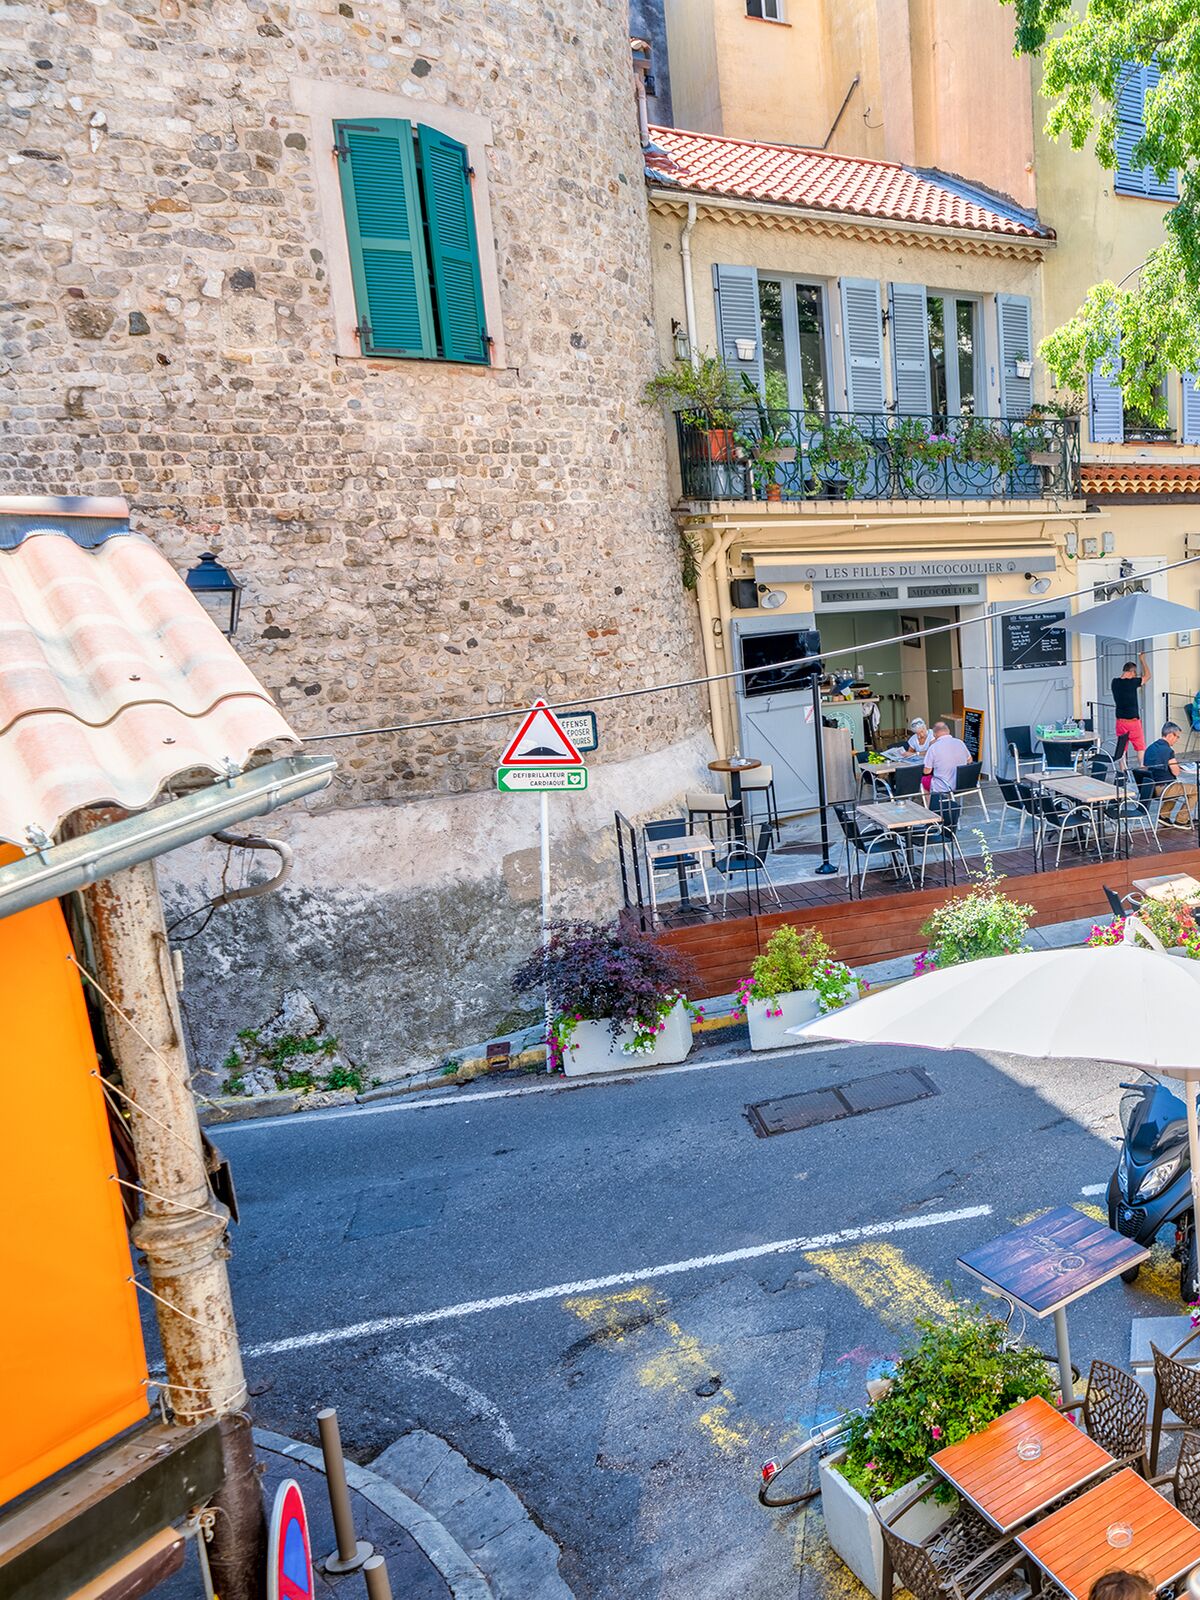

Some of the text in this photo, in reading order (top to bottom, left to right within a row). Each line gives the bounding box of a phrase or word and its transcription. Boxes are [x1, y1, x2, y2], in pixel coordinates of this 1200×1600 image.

[825, 562, 1003, 579] LES FILLES DU MICOCOULIER
[826, 586, 974, 601] LES FILLES DU MICOCOULIER
[561, 719, 587, 729] EFENSE
[567, 728, 591, 738] EPOSER
